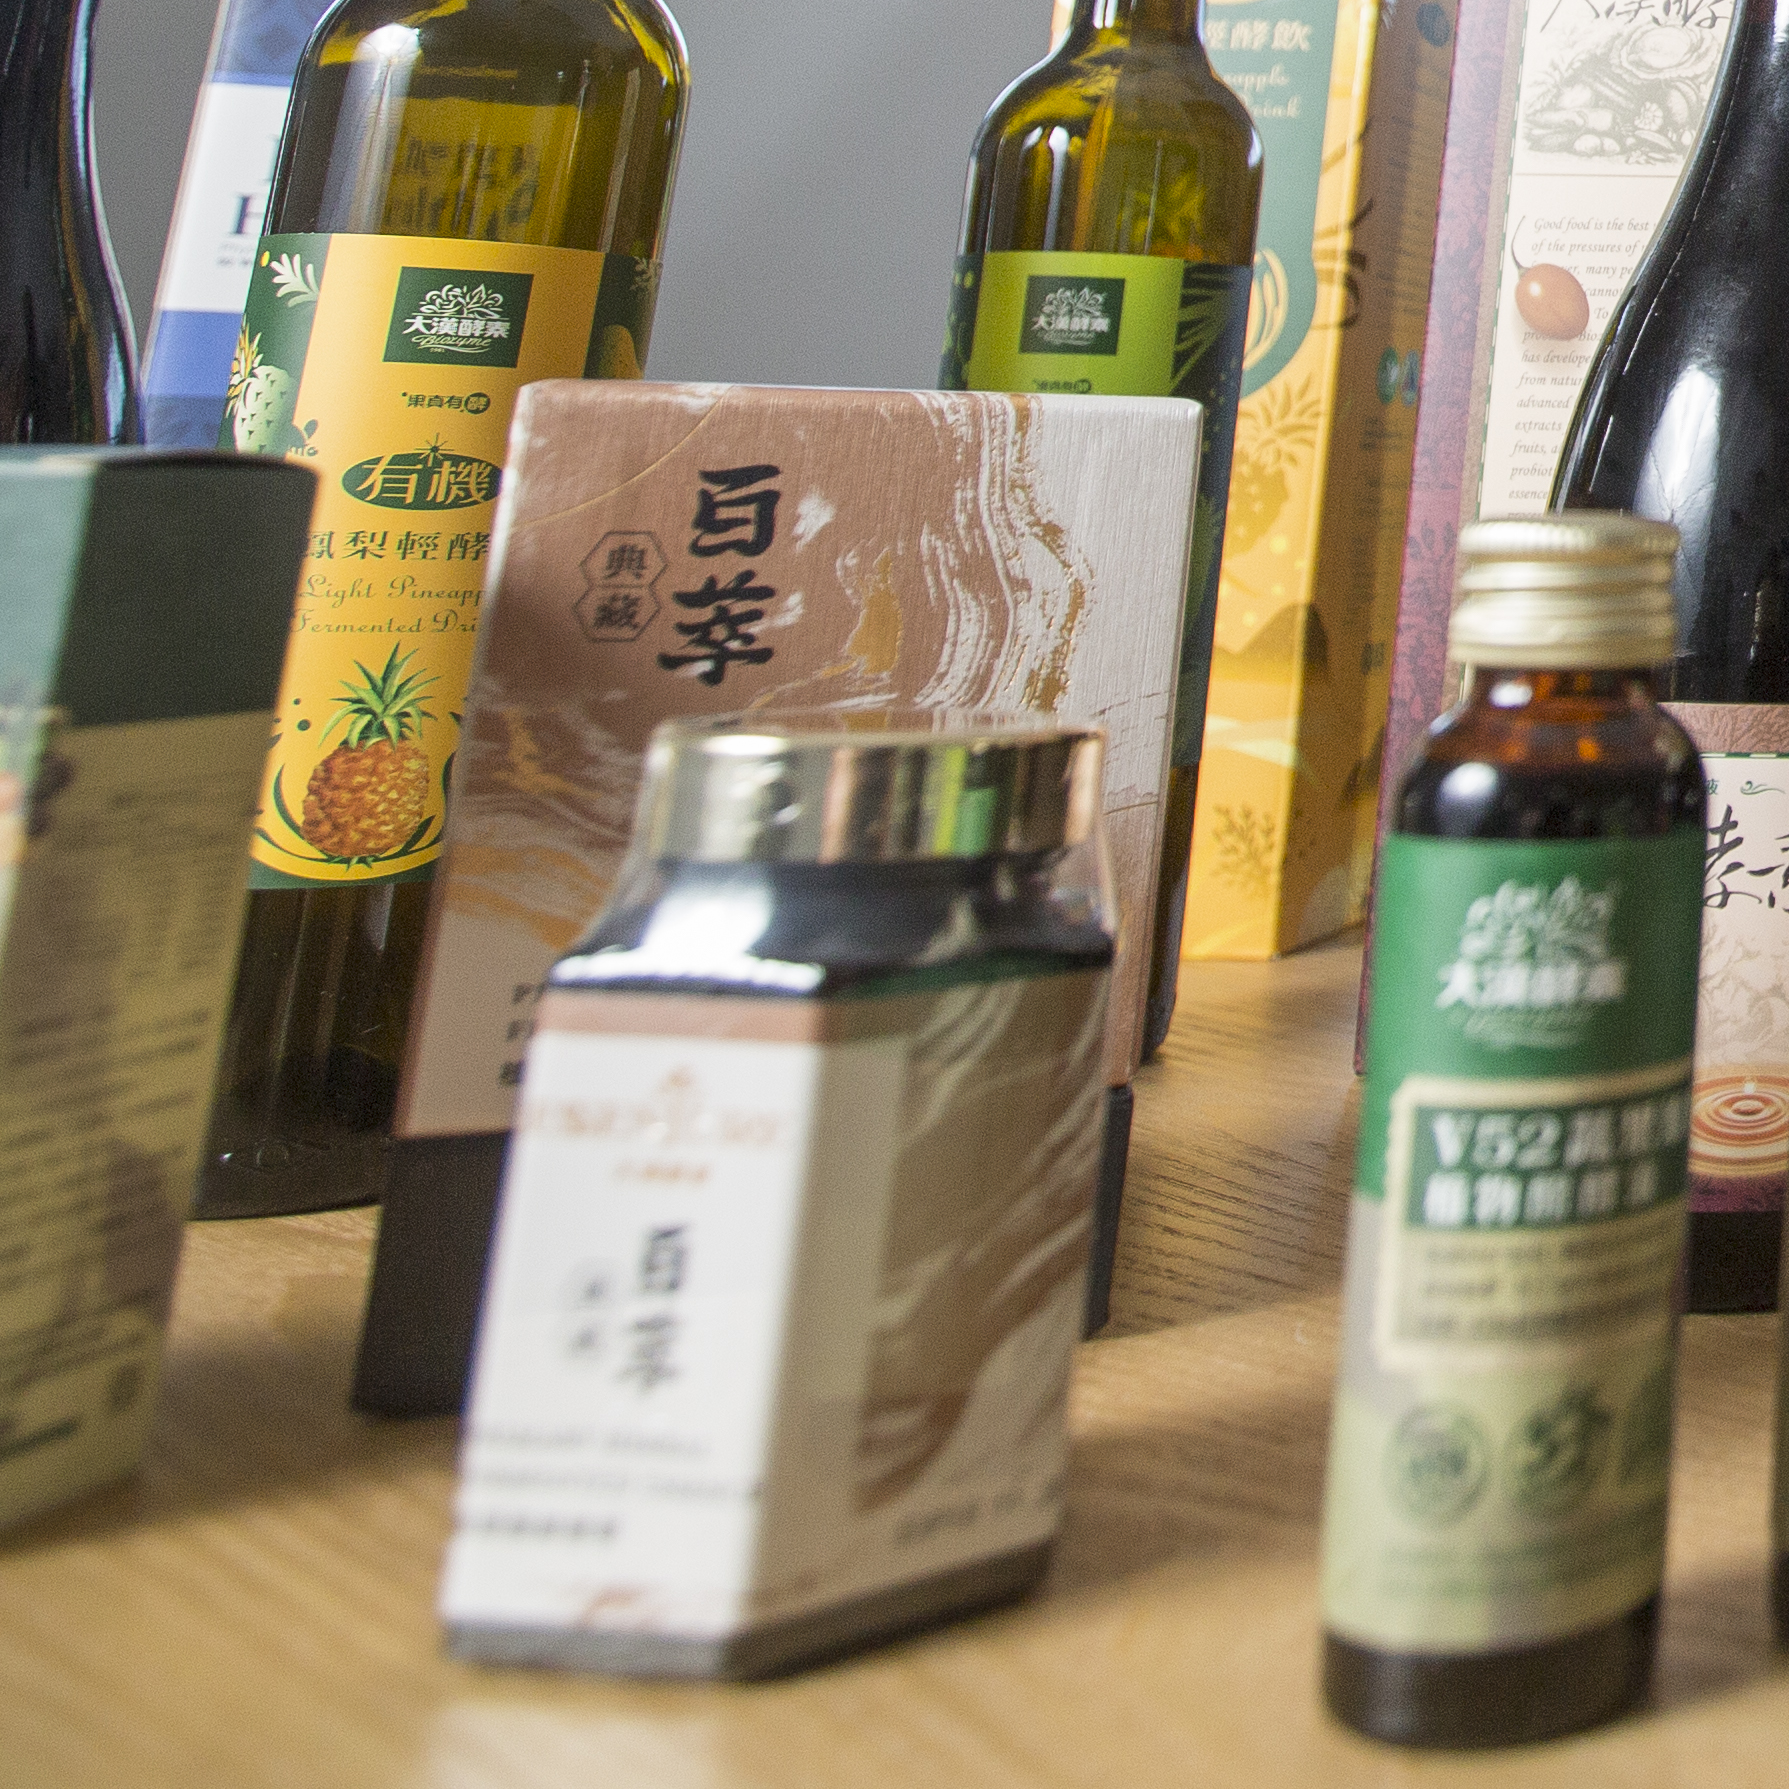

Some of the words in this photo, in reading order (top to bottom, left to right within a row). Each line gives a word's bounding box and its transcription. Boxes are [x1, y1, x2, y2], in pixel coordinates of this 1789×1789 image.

[1534, 217, 1563, 231] Good
[1565, 217, 1594, 233] food
[1594, 220, 1603, 230] is
[1607, 218, 1623, 231] the
[1627, 217, 1649, 231] best
[1531, 239, 1547, 255] of
[1547, 239, 1565, 252] the
[1568, 241, 1621, 254] pressures
[1625, 239, 1642, 257] of
[1586, 266, 1617, 278] many
[1594, 307, 1608, 319] To
[403, 316, 510, 338] 大漢酵素
[411, 334, 492, 350] Biozyme
[1521, 350, 1539, 363] has
[1516, 372, 1546, 389] from
[1517, 394, 1573, 409] advanced
[1515, 421, 1562, 433] extracts
[1509, 439, 1547, 457] fruits,
[355, 453, 492, 506] 有機
[1510, 462, 1553, 480] probiot
[299, 574, 375, 607] Light
[291, 607, 430, 633] Fermented
